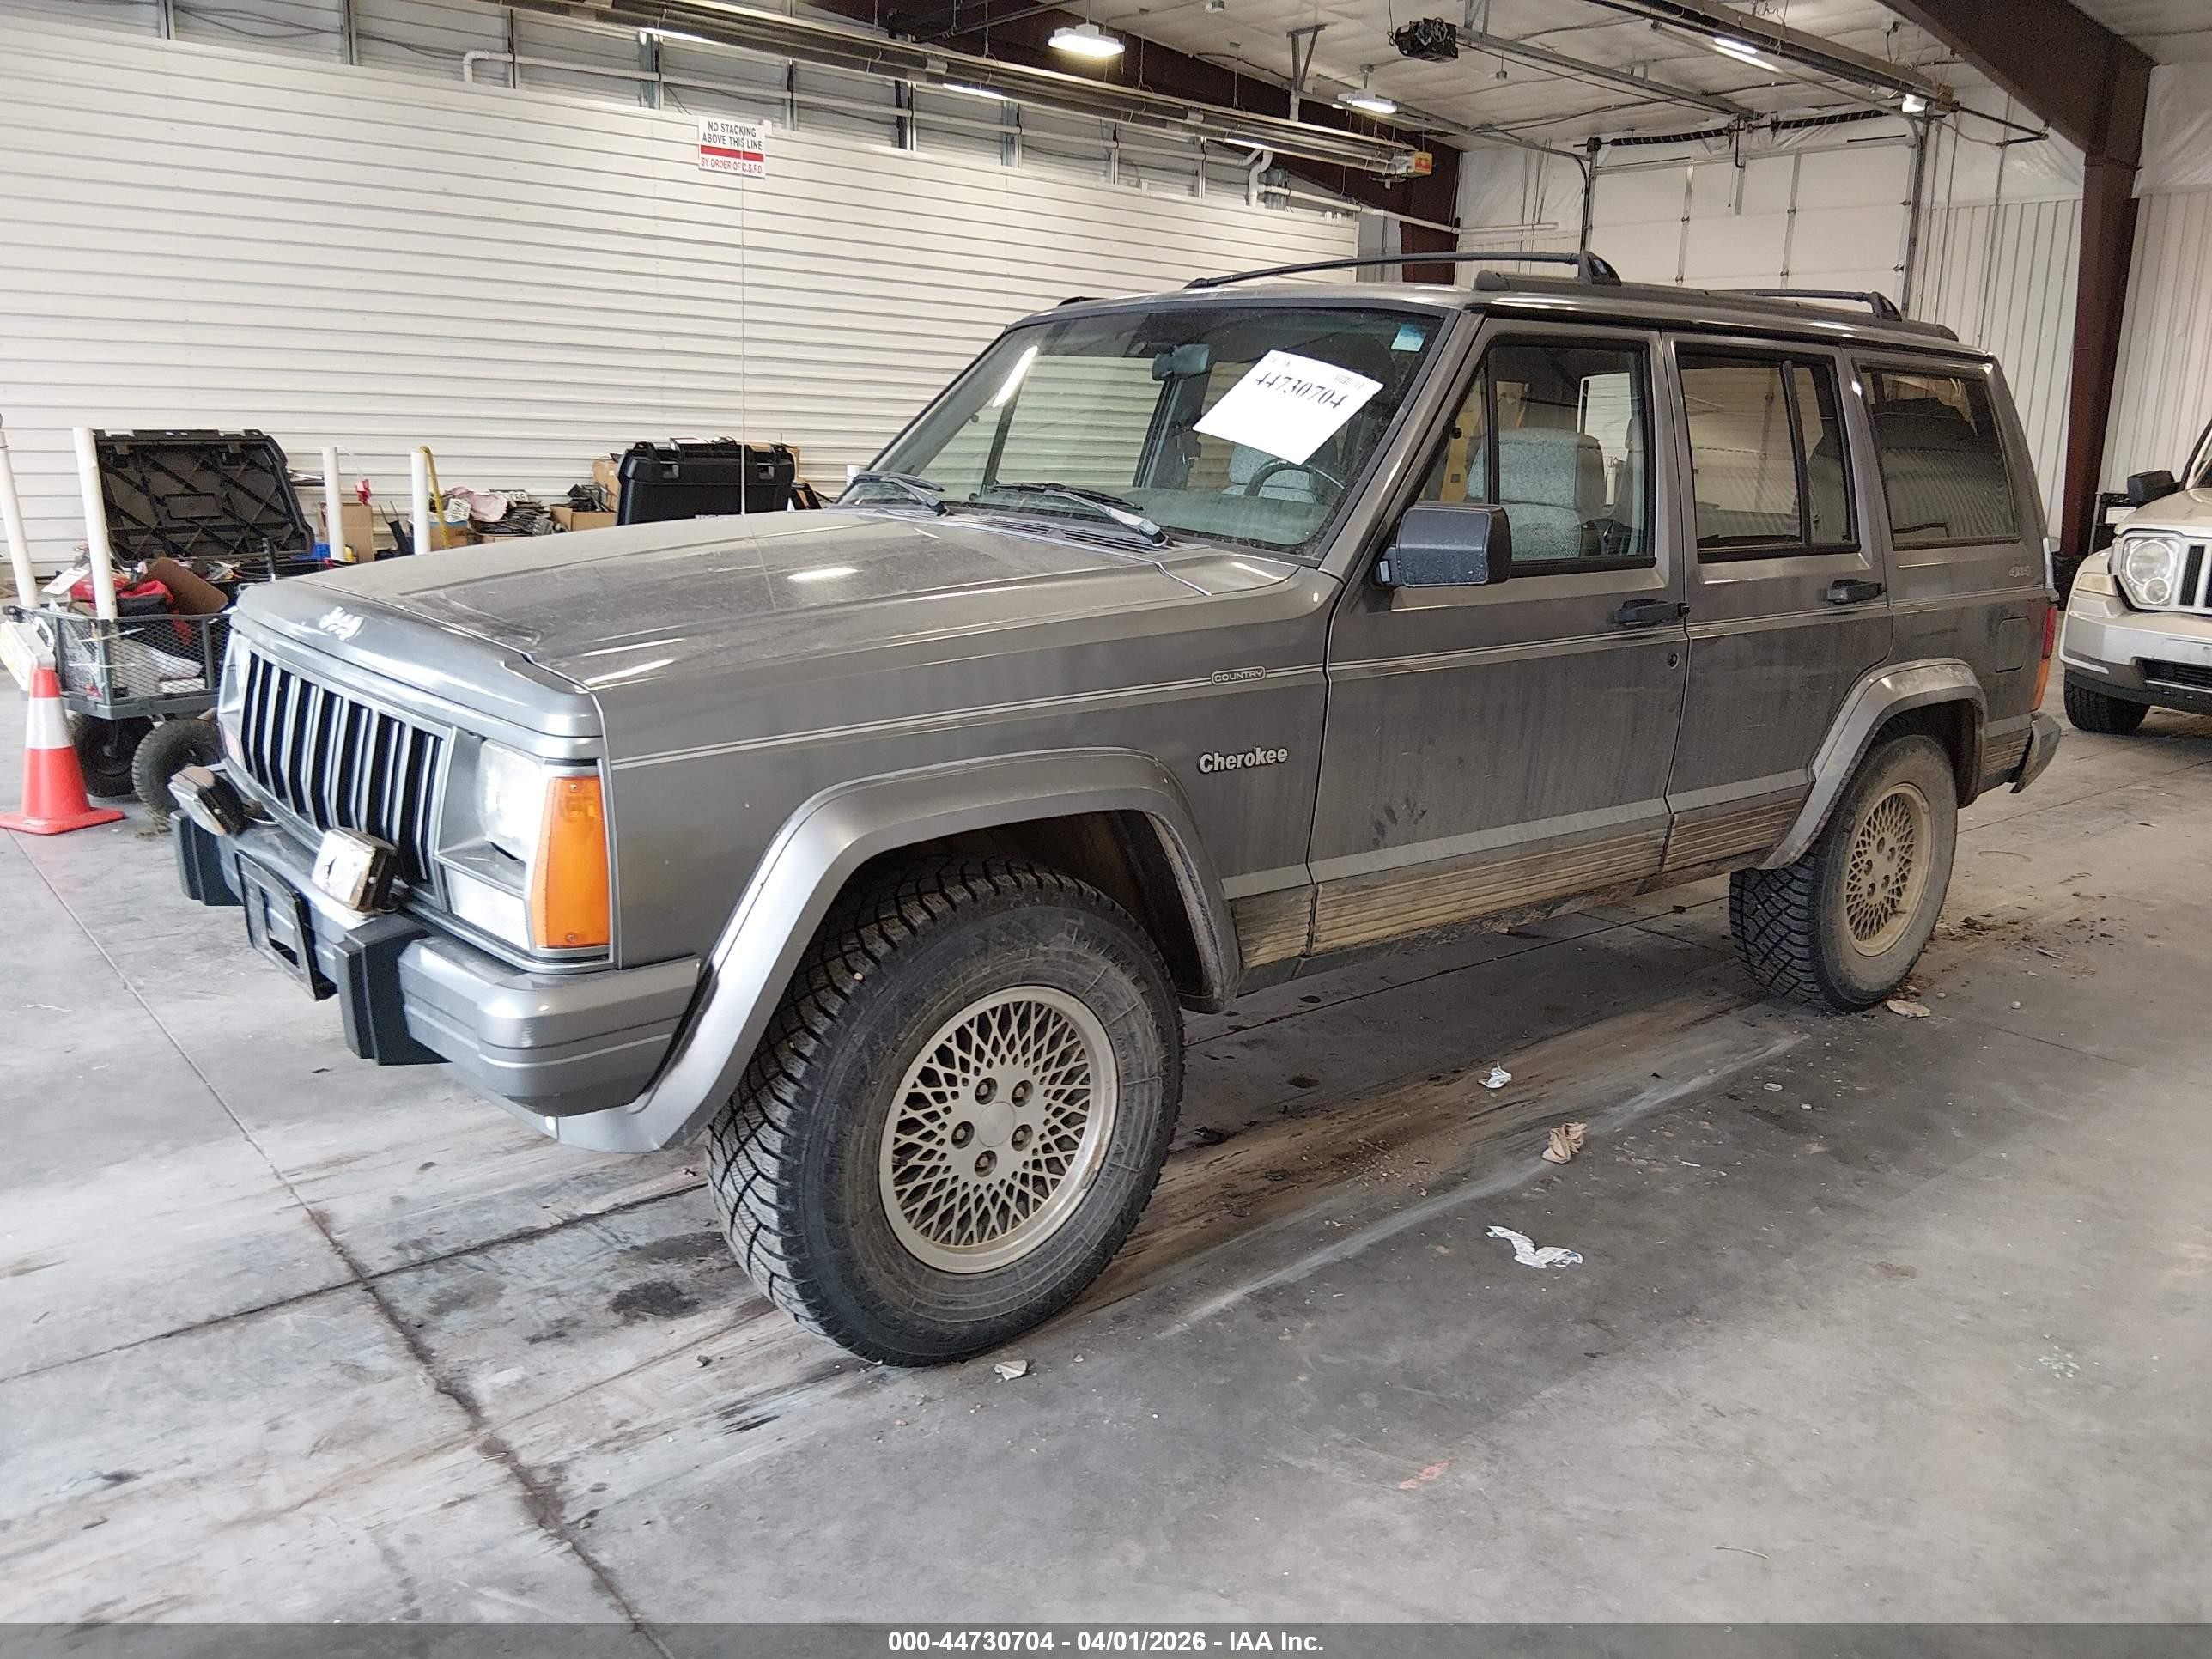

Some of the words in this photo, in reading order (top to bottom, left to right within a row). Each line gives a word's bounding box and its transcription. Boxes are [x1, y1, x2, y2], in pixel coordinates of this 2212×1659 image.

[708, 121, 719, 131] NO
[720, 123, 757, 137] STACKING
[702, 132, 726, 145] ABOVE
[729, 136, 744, 148] THIS
[747, 139, 763, 151] LINE
[701, 157, 708, 167] BY
[711, 159, 732, 170] ORDER
[733, 162, 741, 171] OF
[1255, 372, 1348, 409] 44730704
[1213, 669, 1264, 683] COUNTRY
[1199, 746, 1288, 774] Cherokee
